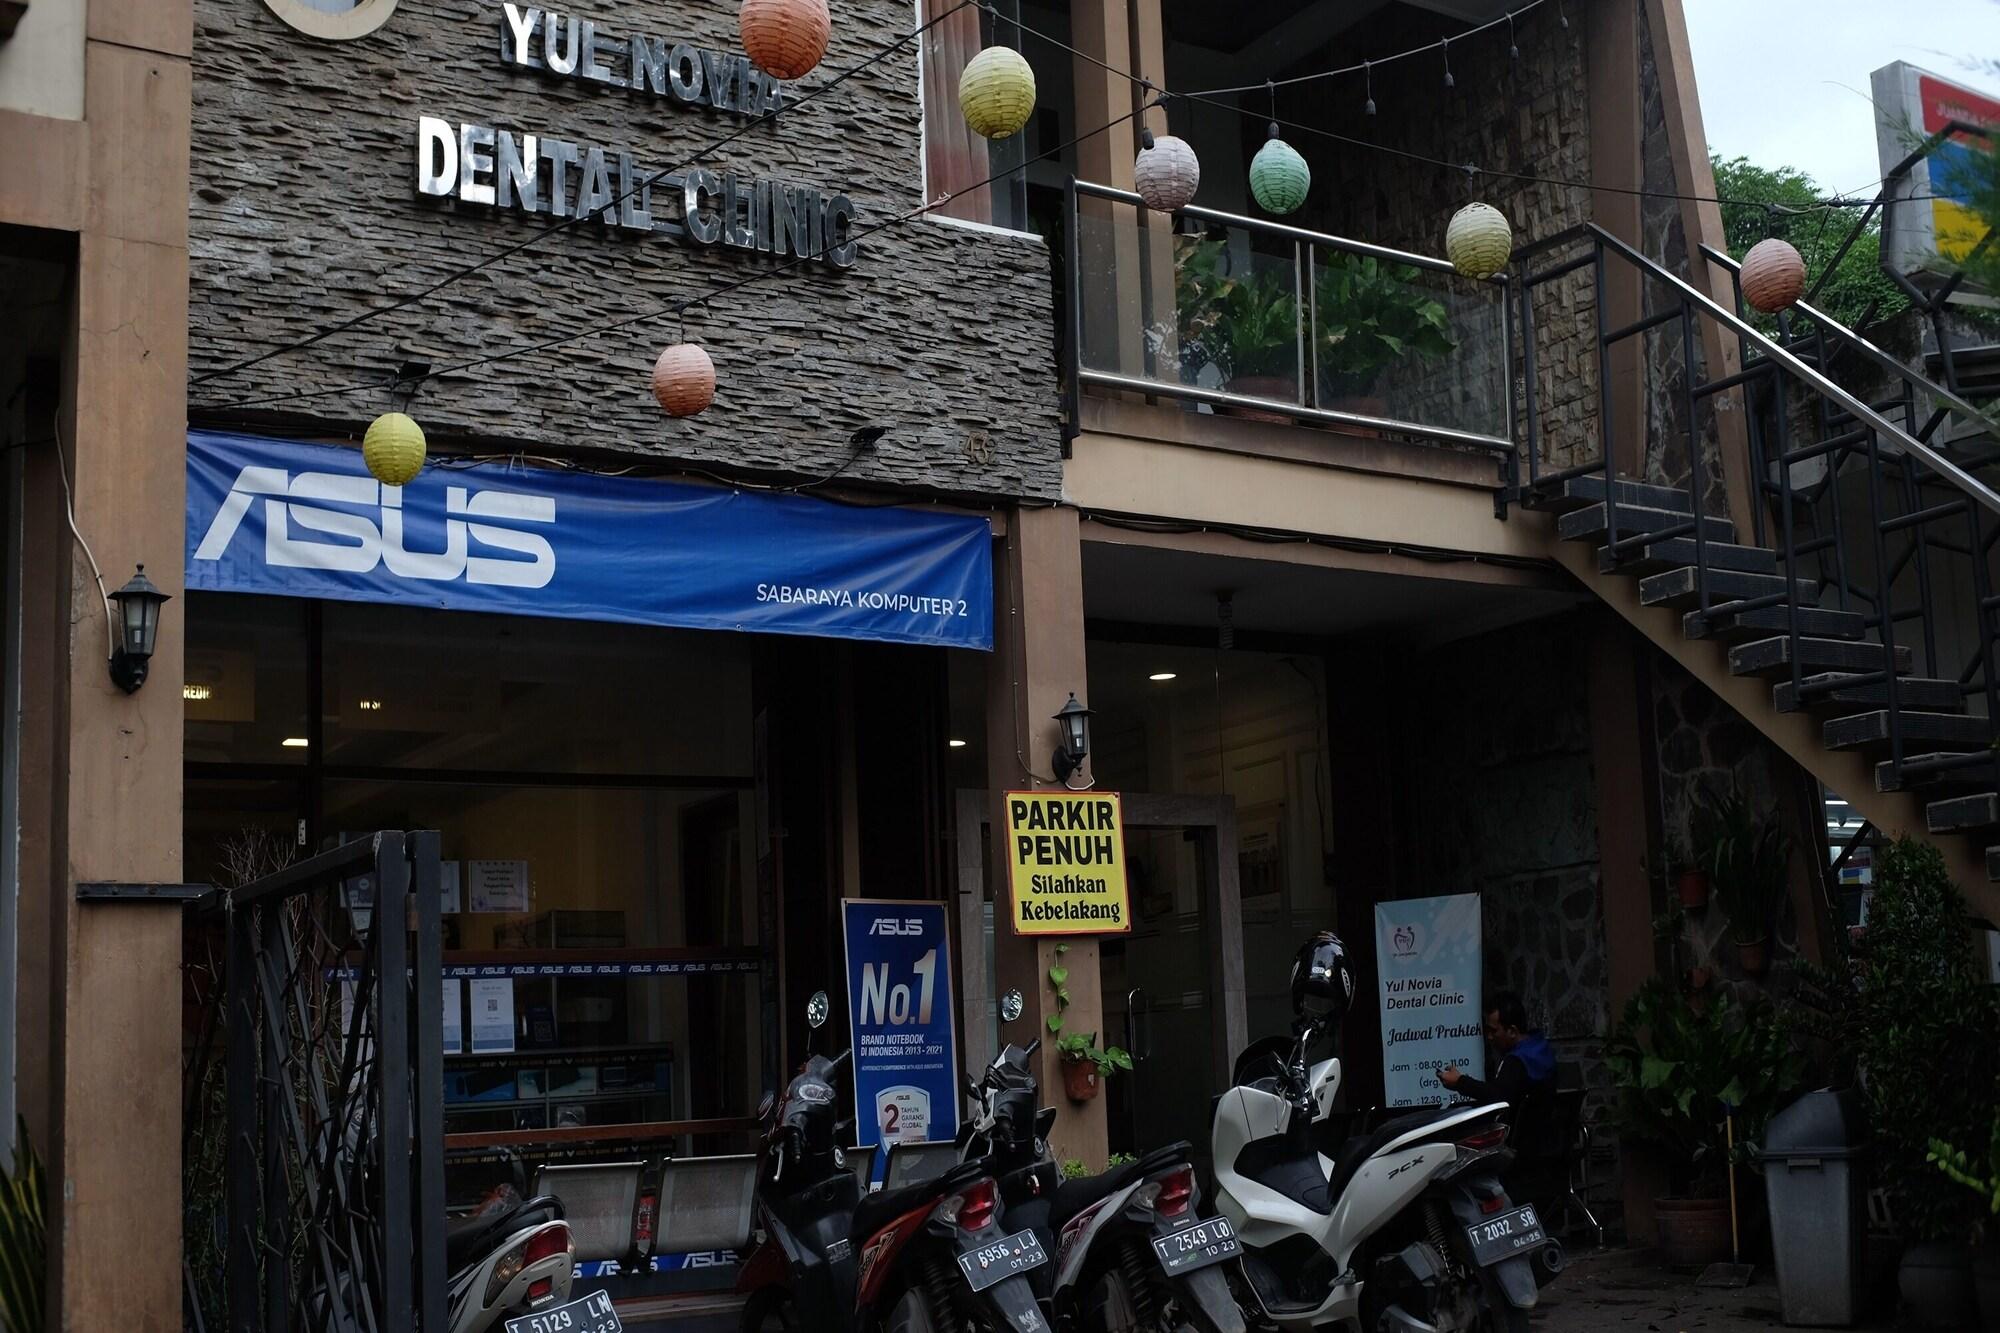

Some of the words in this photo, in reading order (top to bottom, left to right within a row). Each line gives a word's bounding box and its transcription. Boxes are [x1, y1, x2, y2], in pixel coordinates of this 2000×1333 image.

[502, 2, 611, 83] YUL
[631, 32, 786, 119] NOVIA
[418, 115, 653, 231] DENTAL
[684, 168, 858, 268] CLINIC
[193, 465, 556, 588] ASUS
[756, 583, 854, 608] SABARAYA
[858, 591, 954, 616] KOMPUTER
[958, 599, 968, 617] 2
[1011, 800, 1115, 830] PARKIR
[1017, 835, 1114, 865] PENUH
[1031, 874, 1107, 894] Silahkan
[1020, 900, 1121, 923] Kebelakang
[869, 918, 923, 936] ASUS
[451, 967, 476, 976] ASUS
[480, 966, 506, 974] ASUS
[511, 966, 535, 974] ASUS
[540, 966, 564, 974] ASUS
[568, 965, 592, 973] ASUS
[597, 965, 621, 973] ASUS
[628, 965, 652, 973] ASUS
[656, 964, 679, 972] ASUS
[683, 963, 706, 972] ASUS
[860, 949, 937, 1025] No.1
[1385, 979, 1404, 992] Yul
[1408, 977, 1442, 991] Novia
[1387, 995, 1426, 1010] Dental
[1429, 992, 1464, 1006] Clinic
[861, 1034, 885, 1045] BRAND
[886, 1033, 925, 1045] NOTEBOOK
[1387, 1026, 1433, 1046] Jadwal
[1434, 1022, 1482, 1039] Praktek
[860, 1046, 867, 1056] DI
[868, 1046, 904, 1057] INDONESIA
[904, 1045, 921, 1056] 2013
[925, 1045, 943, 1055] 2021
[1390, 1063, 1410, 1072] Jam
[1392, 1098, 1413, 1107] Jam
[884, 1103, 900, 1134] 2
[1388, 1156, 1424, 1179] PCX
[1471, 1229, 1480, 1245] T
[1484, 1219, 1512, 1241] 2032
[1519, 1211, 1535, 1227] SB
[961, 1256, 972, 1272] T
[977, 1243, 1010, 1265] 6956
[1017, 1232, 1037, 1250] LJ
[1159, 1242, 1168, 1257] T
[1175, 1228, 1208, 1252] 2549
[1205, 1244, 1219, 1257] 10
[1221, 1240, 1236, 1252] 23
[531, 1294, 554, 1307] HONDA
[531, 1310, 573, 1333] 5129
